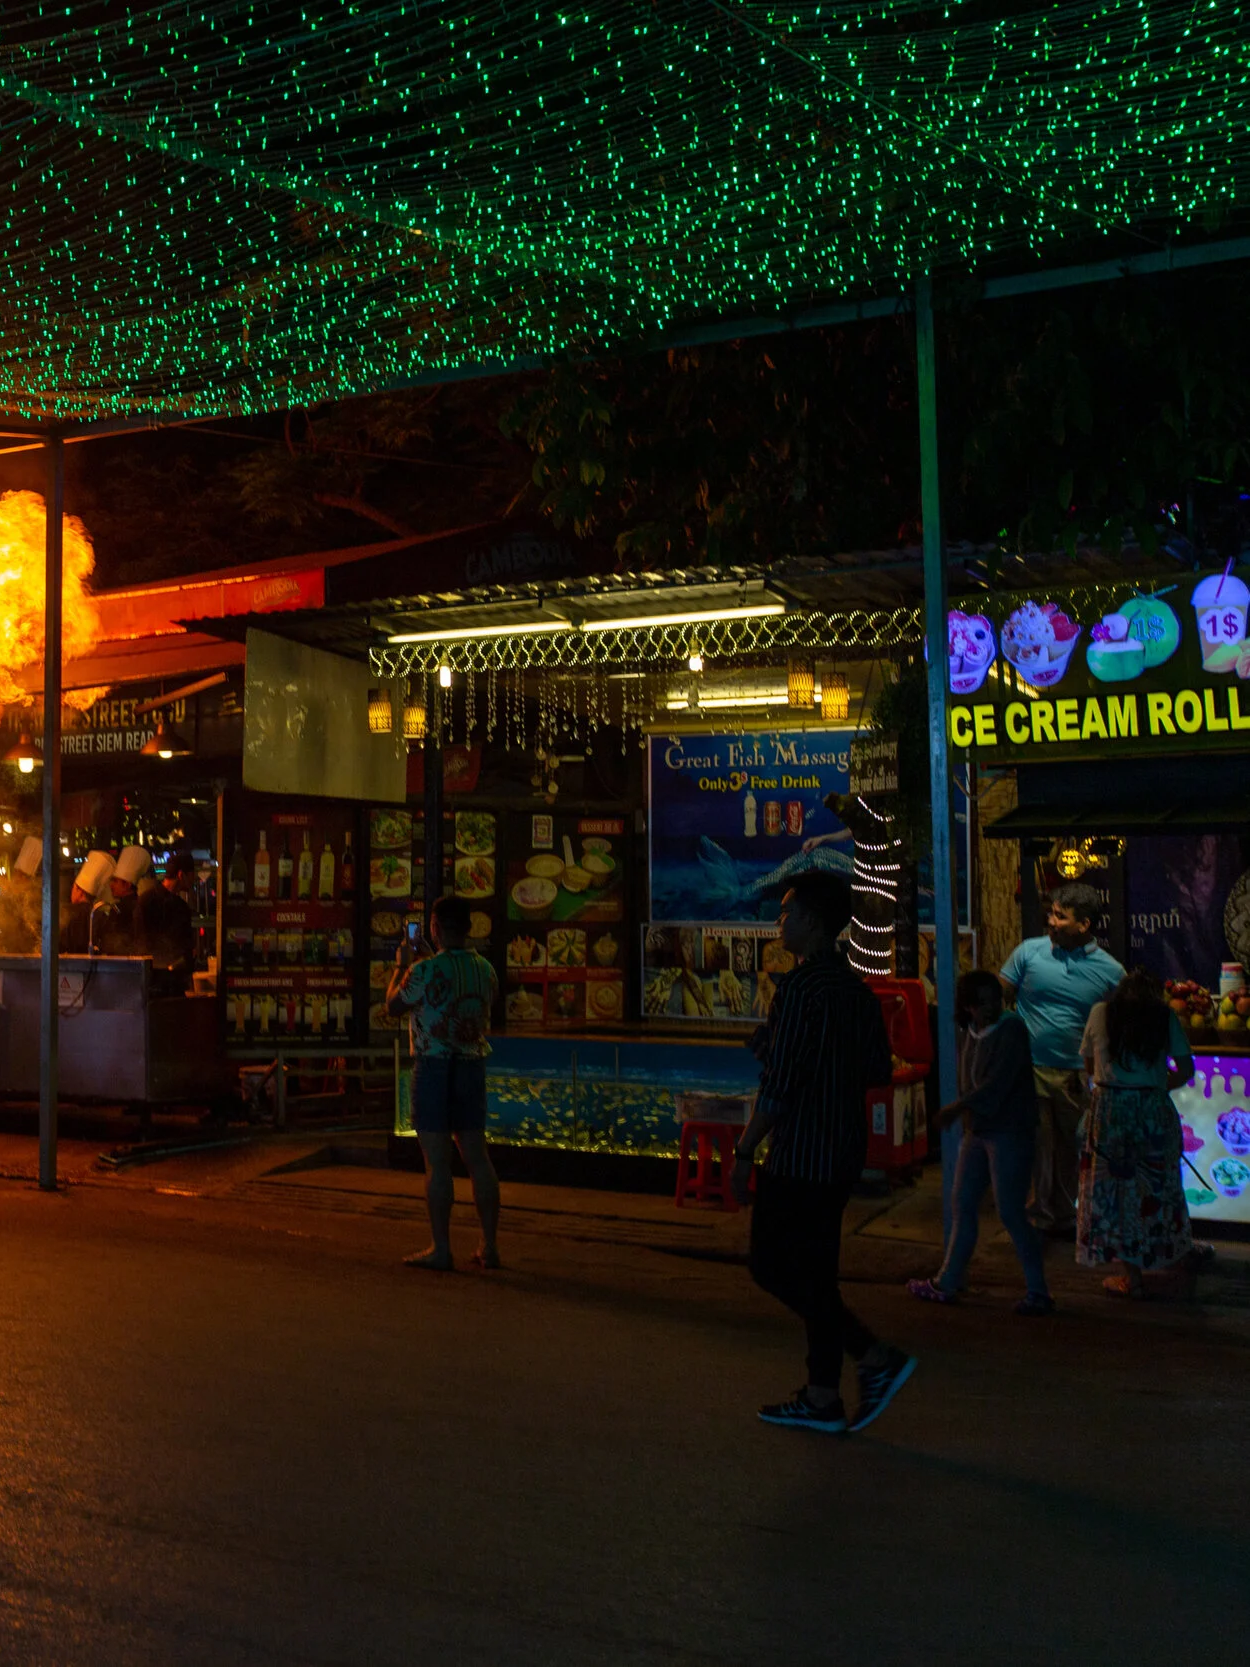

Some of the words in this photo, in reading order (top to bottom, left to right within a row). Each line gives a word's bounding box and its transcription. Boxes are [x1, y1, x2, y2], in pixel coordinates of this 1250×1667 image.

[1133, 616, 1166, 642] 1$
[1206, 612, 1240, 639] 1$
[143, 697, 186, 724] FOD
[951, 704, 998, 748] CE
[1004, 694, 1139, 745] CREAM
[1147, 686, 1250, 736] ROLL
[97, 731, 122, 753] SIEM
[665, 743, 720, 770] Great
[726, 742, 765, 768] Fish
[774, 740, 849, 773] Massag
[698, 776, 729, 792] Only
[750, 775, 778, 790] Free
[781, 774, 821, 789] Drink
[276, 911, 306, 923] COCKTAILS
[705, 927, 740, 937] Henna
